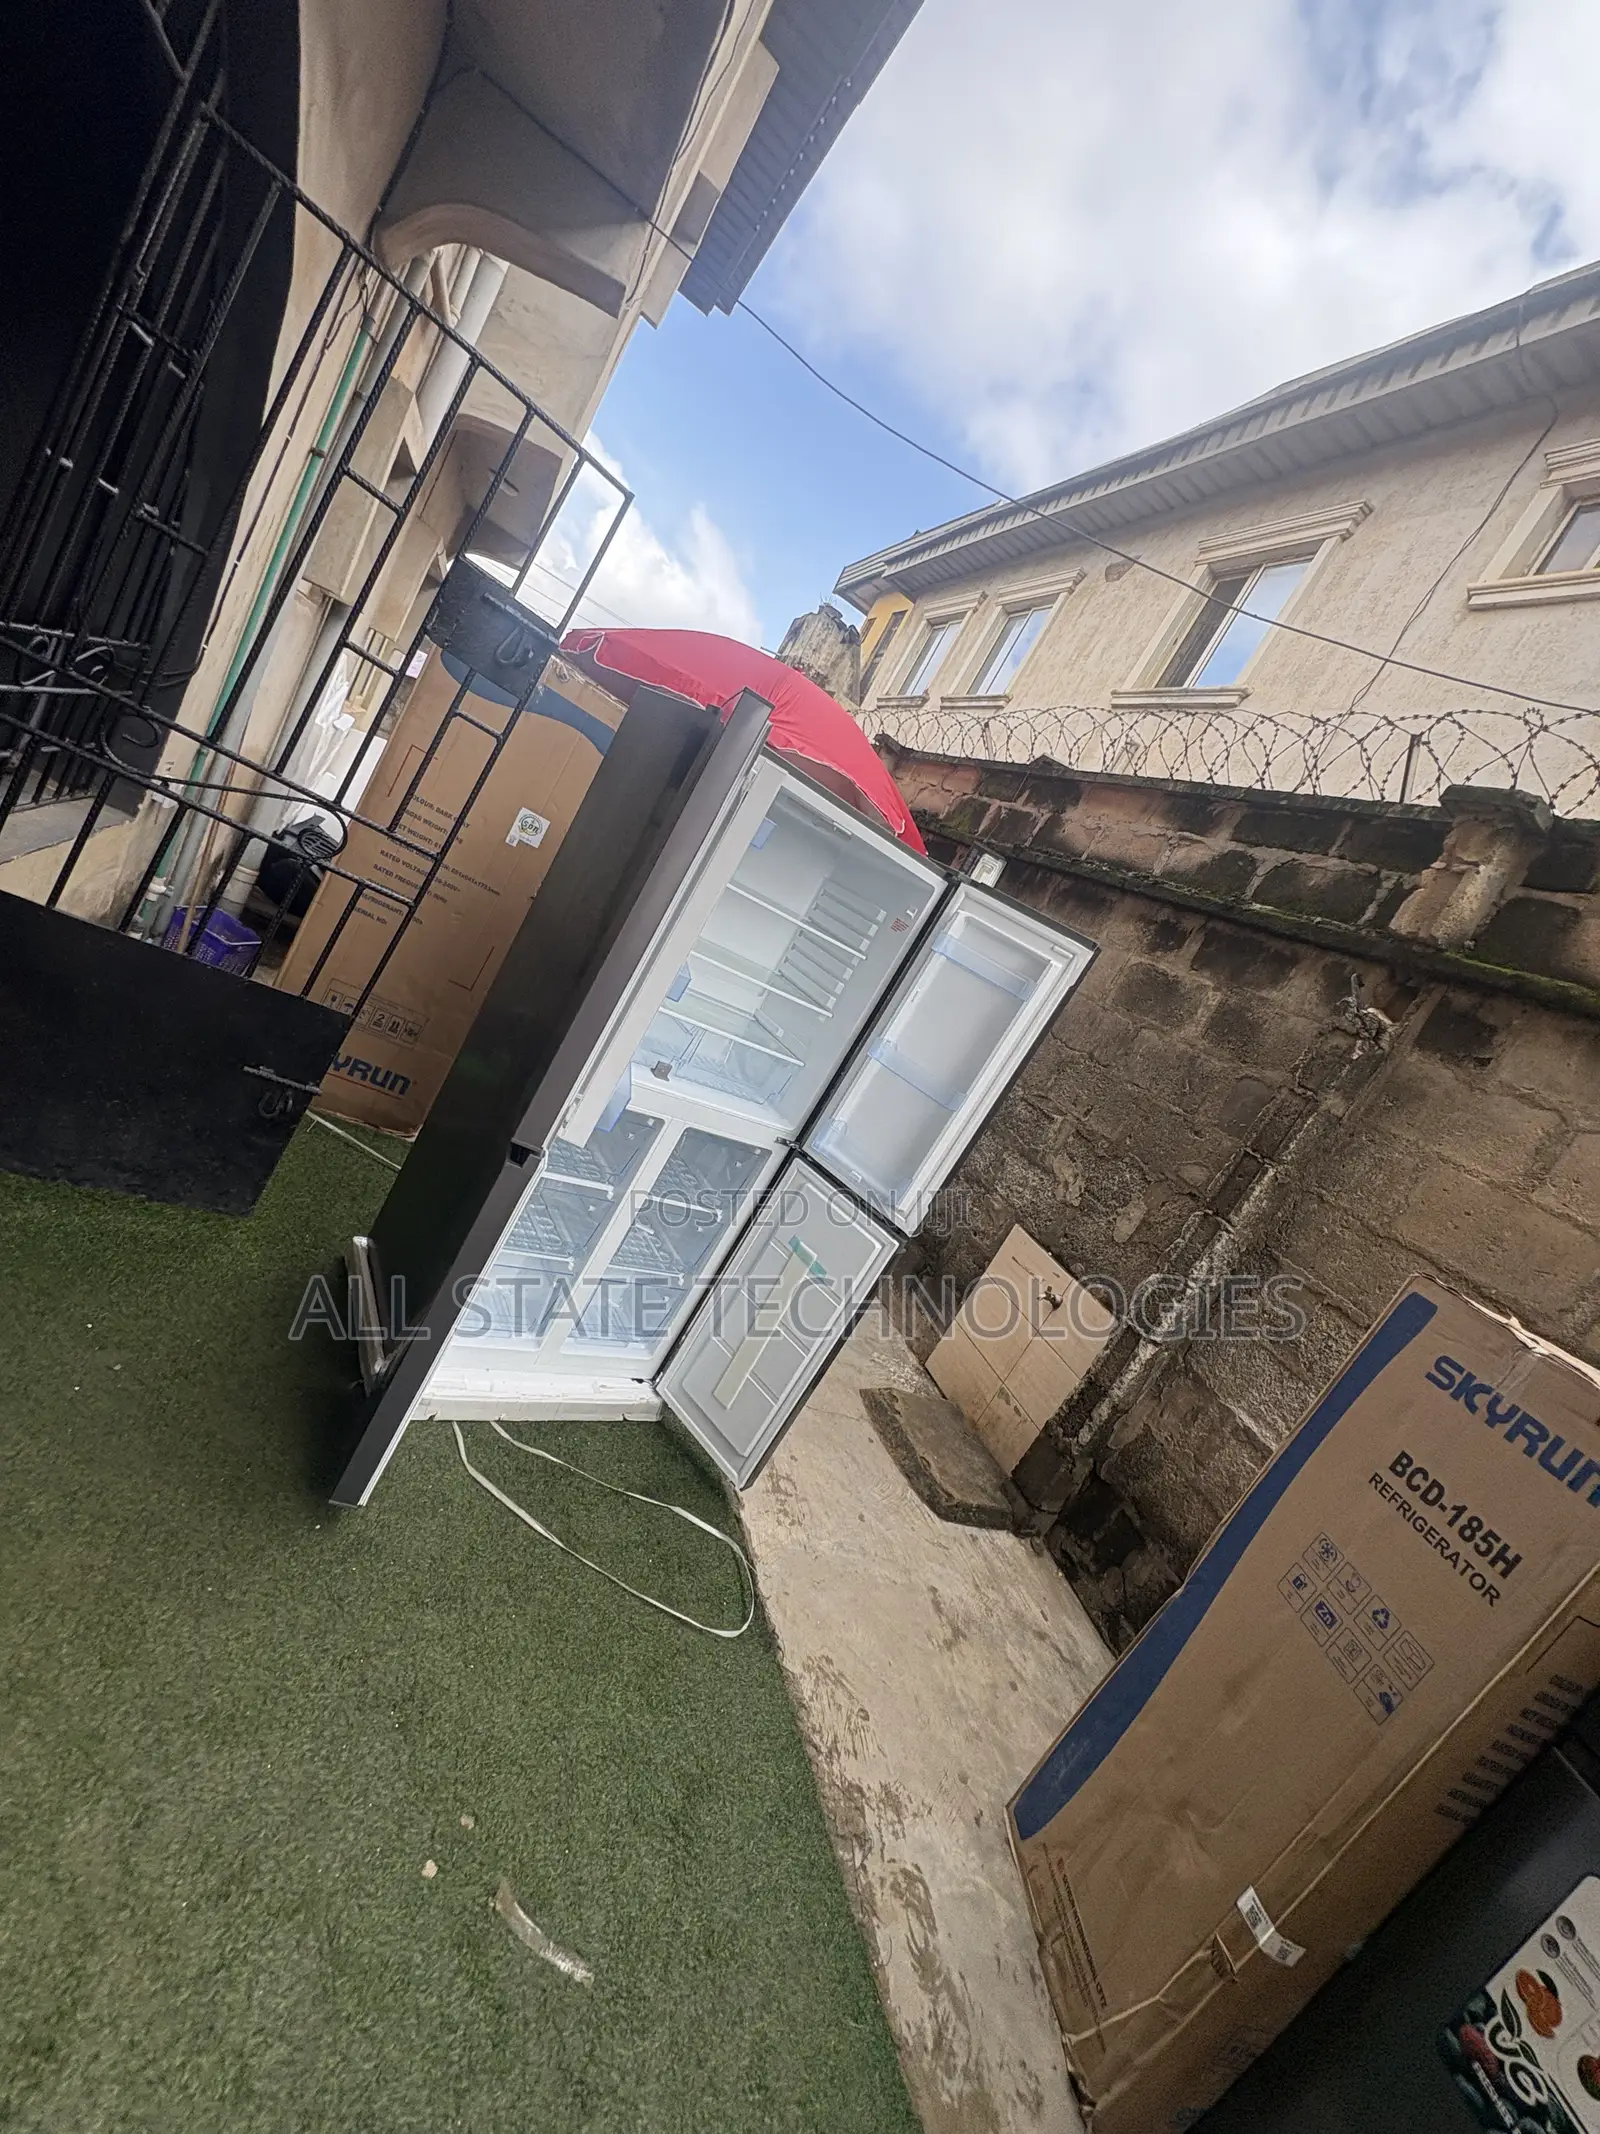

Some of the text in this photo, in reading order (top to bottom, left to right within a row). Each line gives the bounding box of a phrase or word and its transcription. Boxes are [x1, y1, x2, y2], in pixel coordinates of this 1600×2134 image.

[332, 1053, 412, 1096] YRUN
[1367, 1471, 1502, 1608] REFRIGERATOR
[1388, 1450, 1524, 1580] BCD-185H
